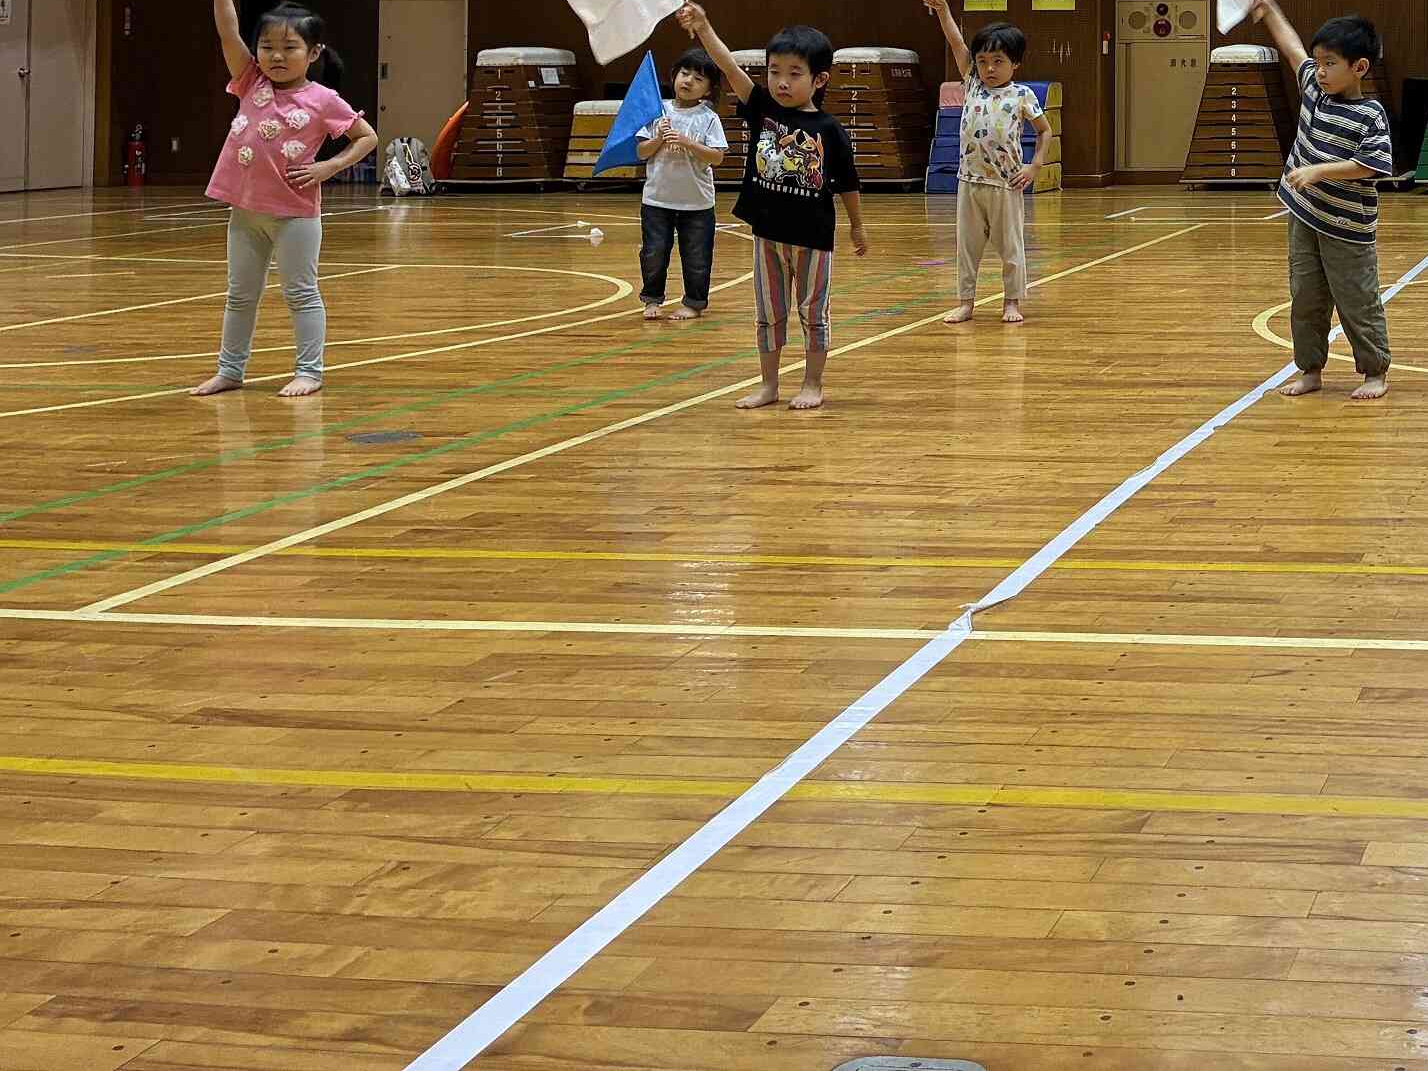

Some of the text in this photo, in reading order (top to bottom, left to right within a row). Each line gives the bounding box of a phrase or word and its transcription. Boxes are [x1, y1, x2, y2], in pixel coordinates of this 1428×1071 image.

[1231, 87, 1237, 95] 2
[1231, 101, 1237, 109] 3
[1231, 114, 1236, 122] 4
[1231, 128, 1237, 136] 5
